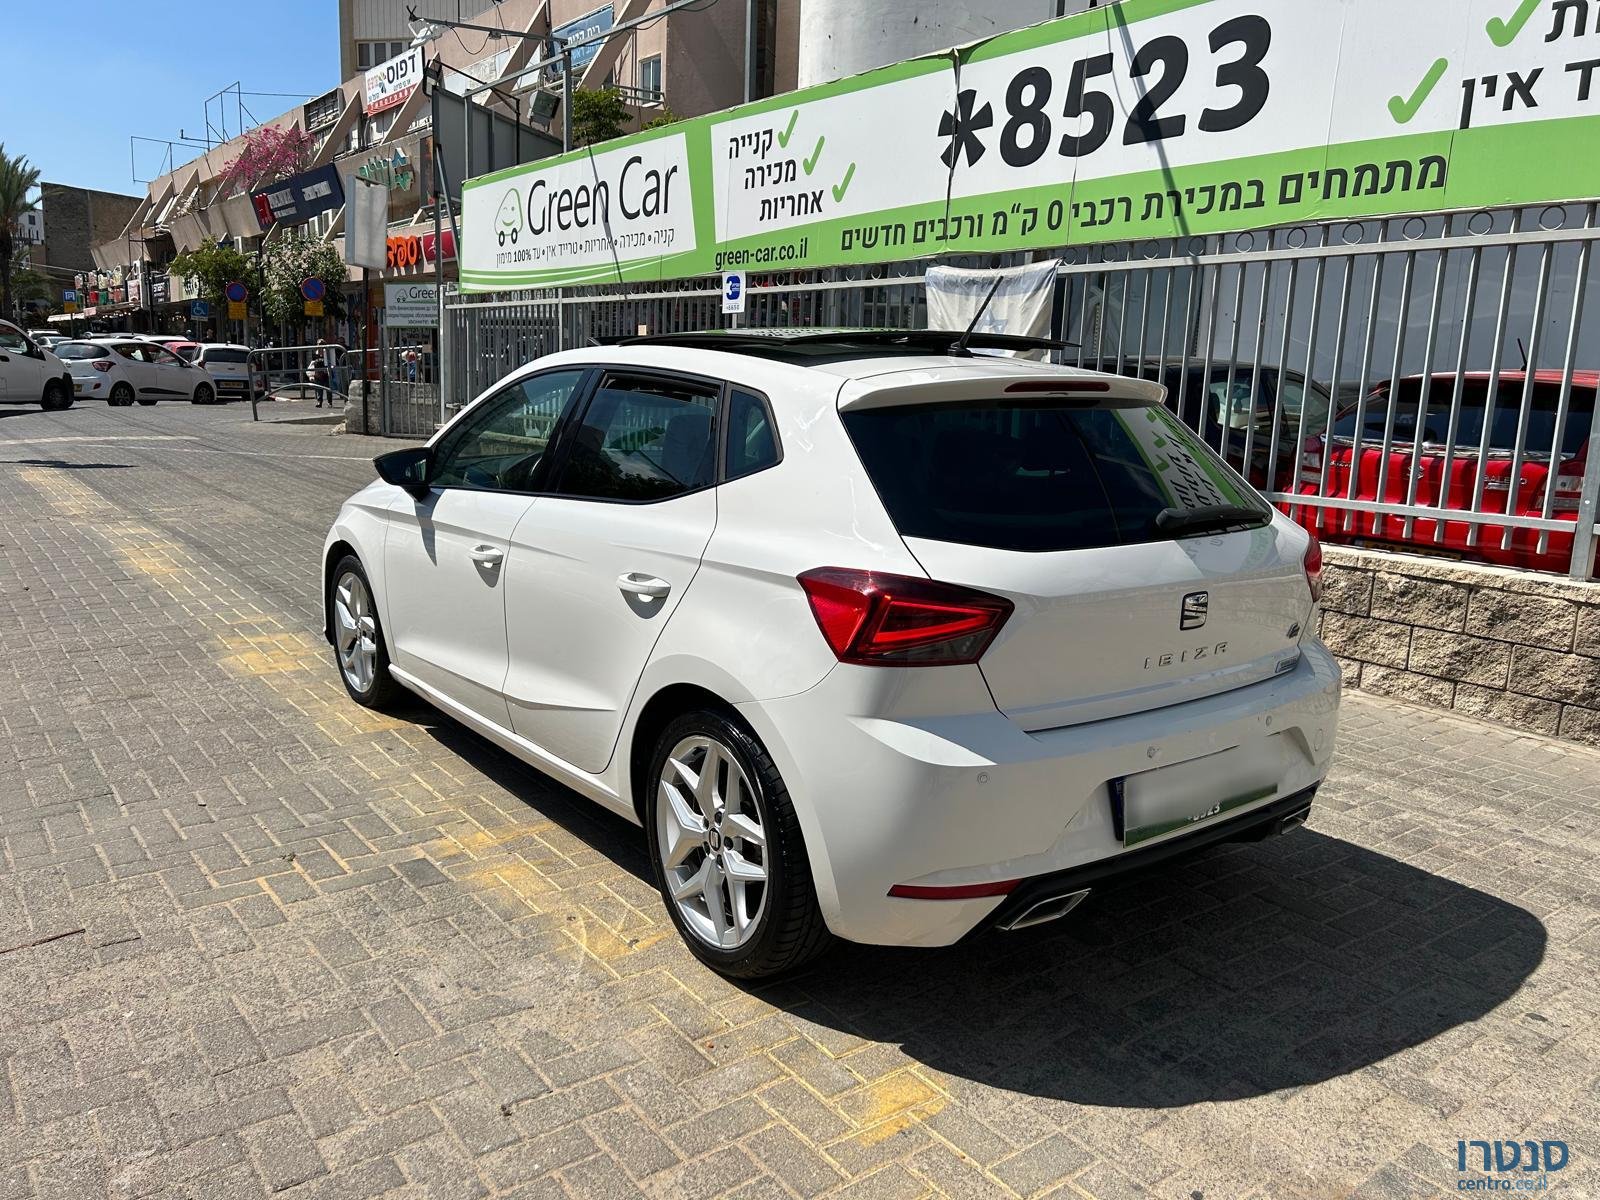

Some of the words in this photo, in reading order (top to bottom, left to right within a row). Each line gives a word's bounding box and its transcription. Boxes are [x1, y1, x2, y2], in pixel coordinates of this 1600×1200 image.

[386, 53, 416, 84] דפוס
[1459, 67, 1544, 130] אין
[729, 128, 773, 160] קנייה
[744, 159, 797, 190] מכירה
[1278, 154, 1448, 205] מתמחים
[527, 179, 609, 236] Green
[619, 155, 678, 220] Car
[759, 190, 825, 222] אחריות
[1140, 178, 1265, 221] במכירת
[1046, 199, 1064, 231] 0
[1071, 196, 1132, 228] רכבי
[619, 232, 646, 248] מכירה
[653, 228, 675, 247] קניה
[841, 223, 906, 251] חדשים
[912, 213, 984, 244] ורכבים
[496, 251, 512, 268] מימון
[513, 250, 532, 263] 100%
[532, 248, 541, 260] עד
[546, 246, 557, 262] אין
[557, 241, 578, 256] טרייד
[584, 237, 613, 253] אחריות
[715, 237, 808, 271] green-car.co.il
[1483, 474, 1528, 486] BALEO
[1144, 641, 1229, 670] IBIZA
